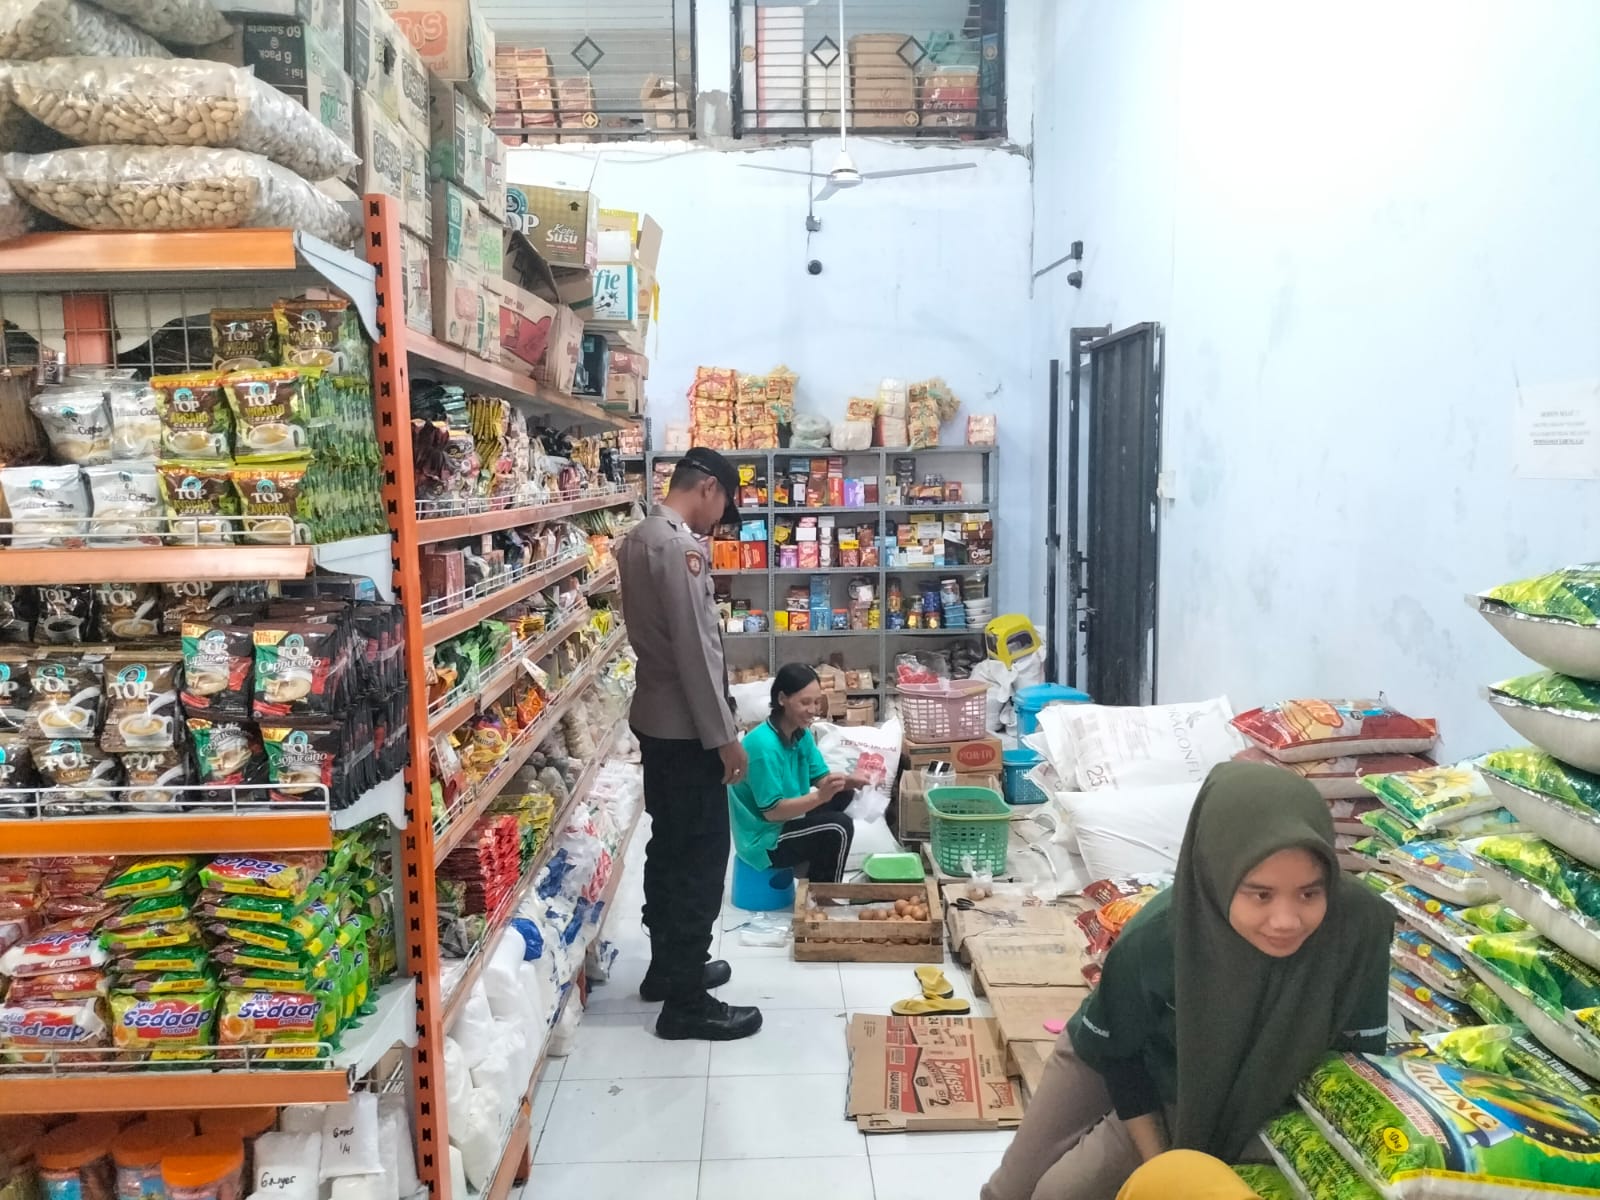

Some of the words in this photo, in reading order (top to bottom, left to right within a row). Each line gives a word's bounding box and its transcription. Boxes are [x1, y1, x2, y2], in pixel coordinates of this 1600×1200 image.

[287, 25, 302, 38] 60
[284, 51, 292, 64] 6
[545, 230, 578, 244] Susu
[297, 320, 328, 331] TOP
[222, 329, 254, 341] TOP
[173, 400, 201, 412] TOP
[244, 394, 277, 406] TOP
[174, 487, 207, 500] TOP
[251, 492, 283, 503] TOP
[38, 587, 71, 603] TOP
[167, 581, 213, 598] TOP
[96, 589, 137, 606] TOP
[31, 676, 79, 695] TOP
[107, 681, 155, 700] TOP
[238, 1000, 322, 1019] Sedaap
[123, 1009, 213, 1029] Sedaap
[929, 1098, 951, 1107] 2
